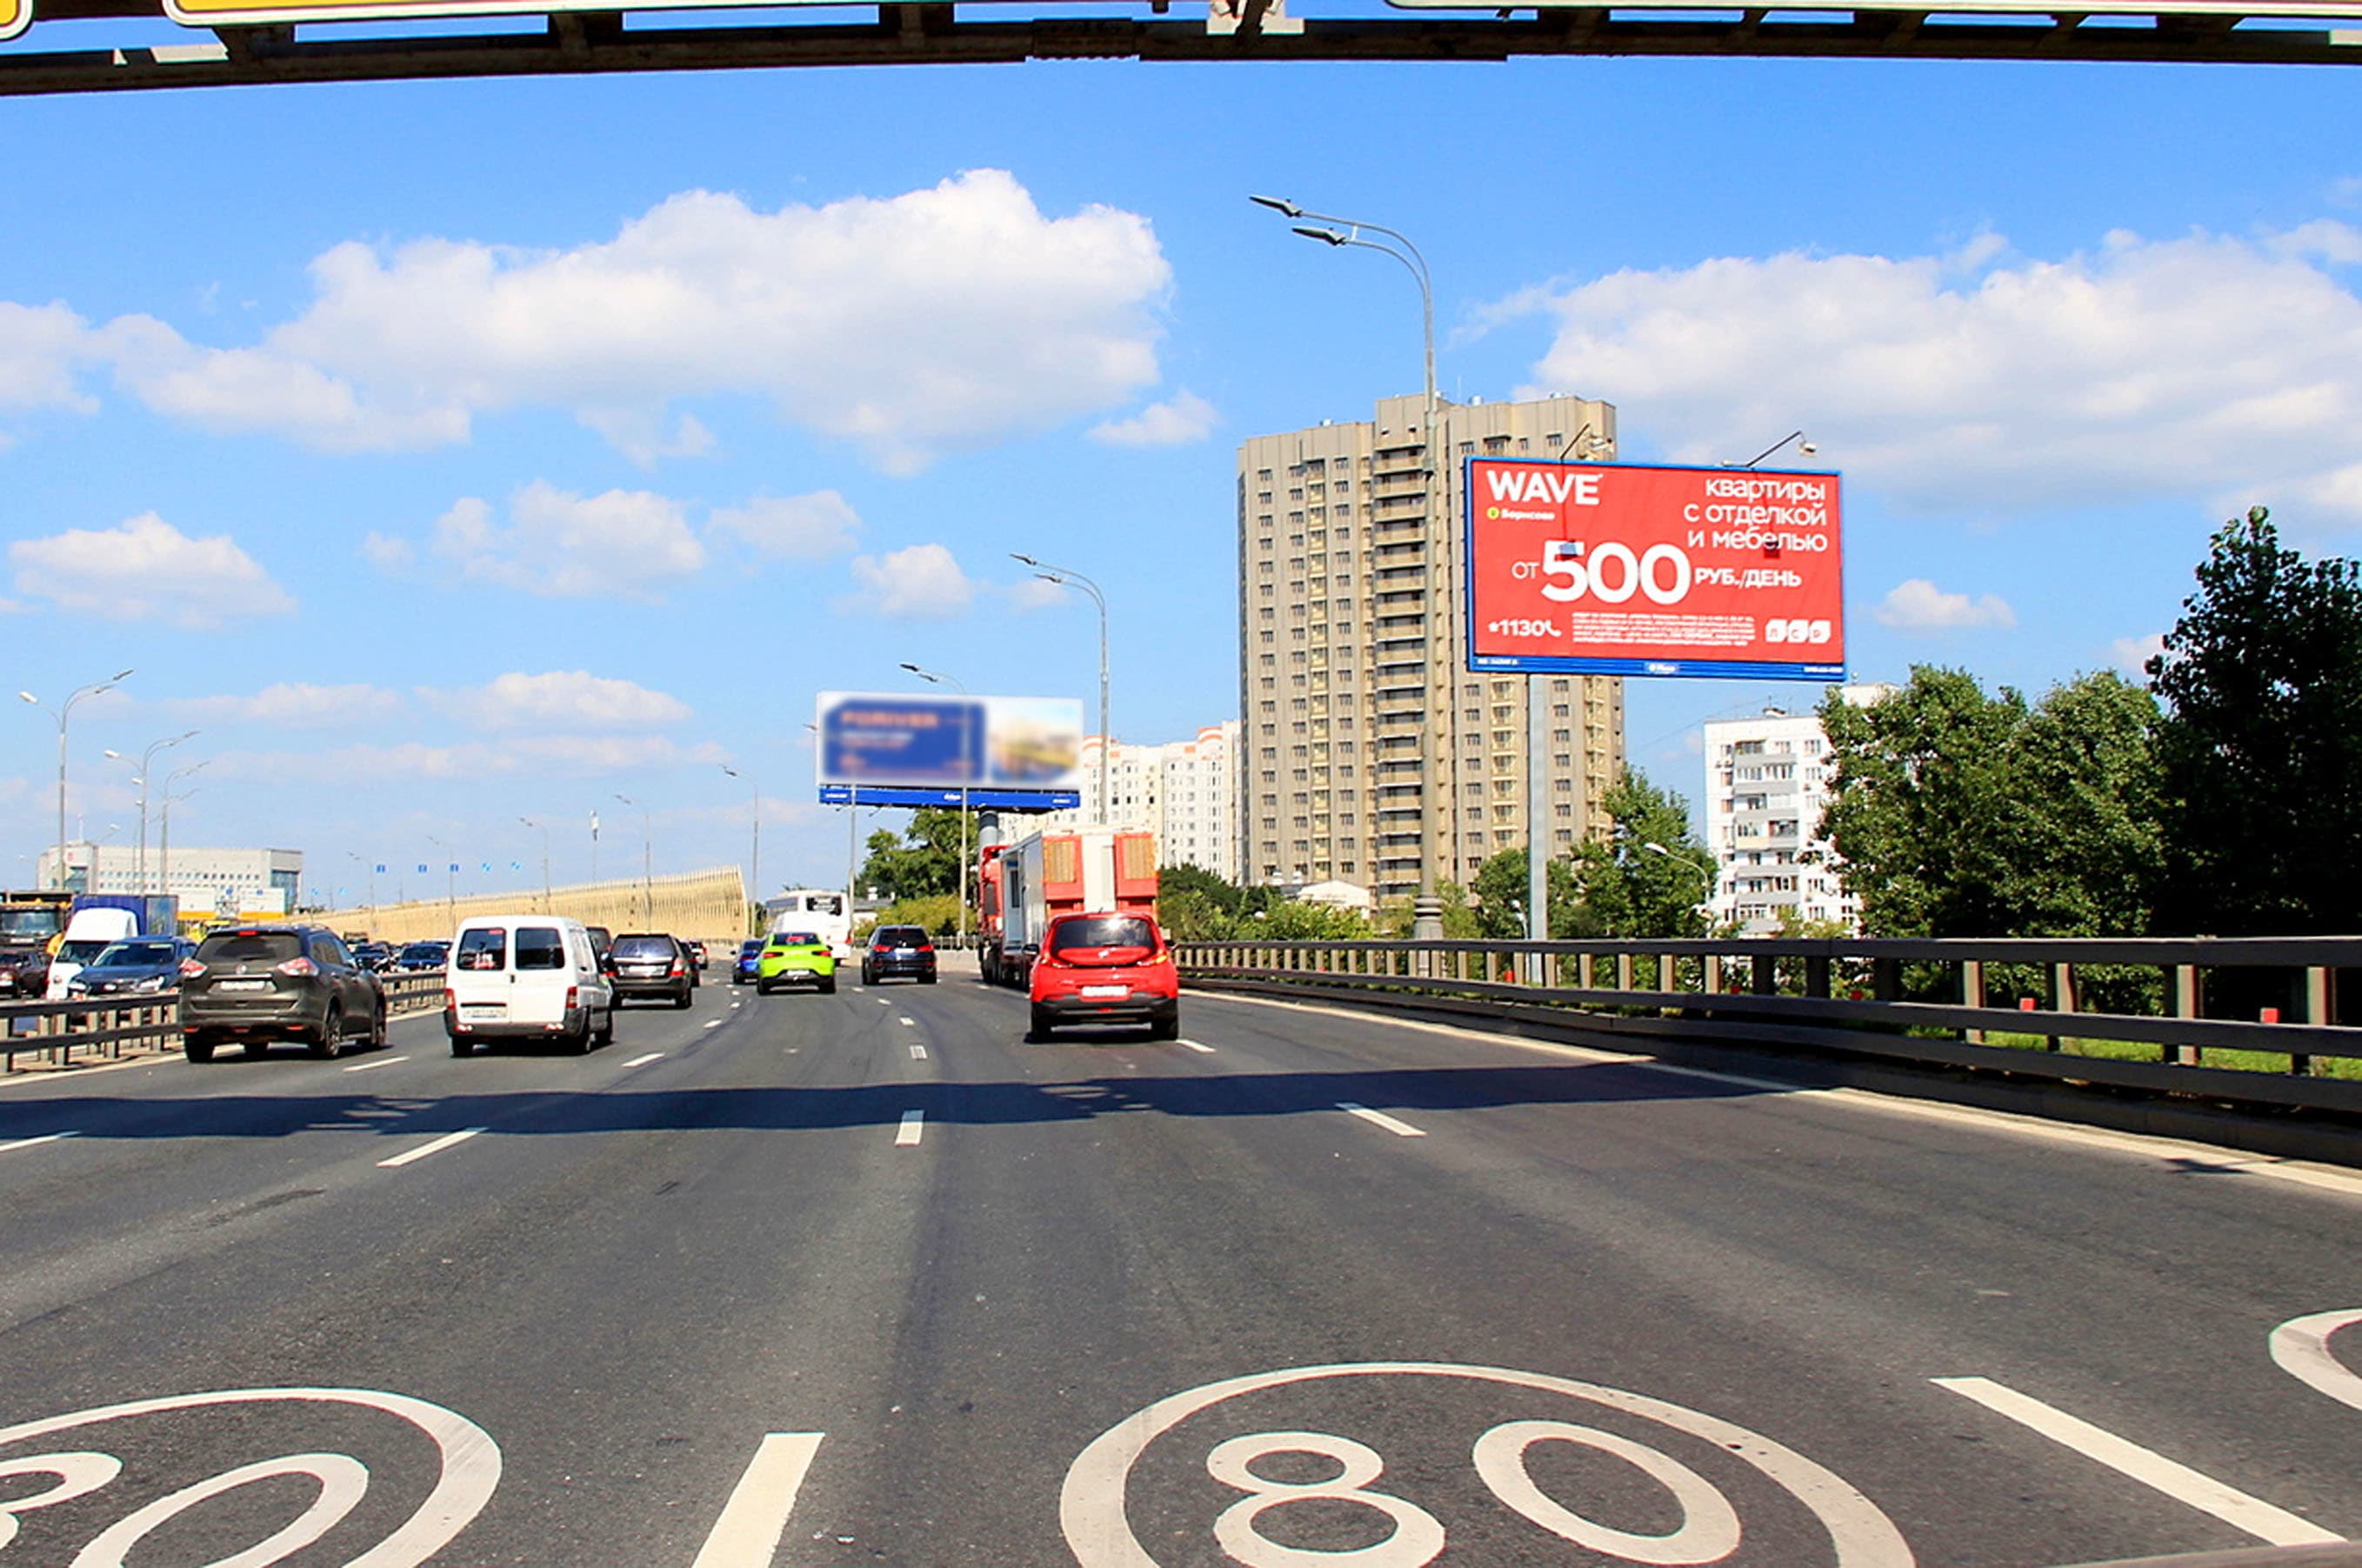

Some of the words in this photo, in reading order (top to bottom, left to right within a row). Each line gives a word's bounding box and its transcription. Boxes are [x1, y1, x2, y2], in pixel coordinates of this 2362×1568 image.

[1485, 469, 1603, 505] WAVE
[1705, 478, 1826, 505] квартиры
[1683, 504, 1700, 522] с
[1705, 502, 1827, 527] отделкой
[1687, 530, 1705, 549] и
[1711, 525, 1828, 552] мебелью
[1541, 540, 1692, 605] 500
[1695, 567, 1803, 590] РУБ./ДЕНЬ
[1207, 1420, 1741, 1568] 80
